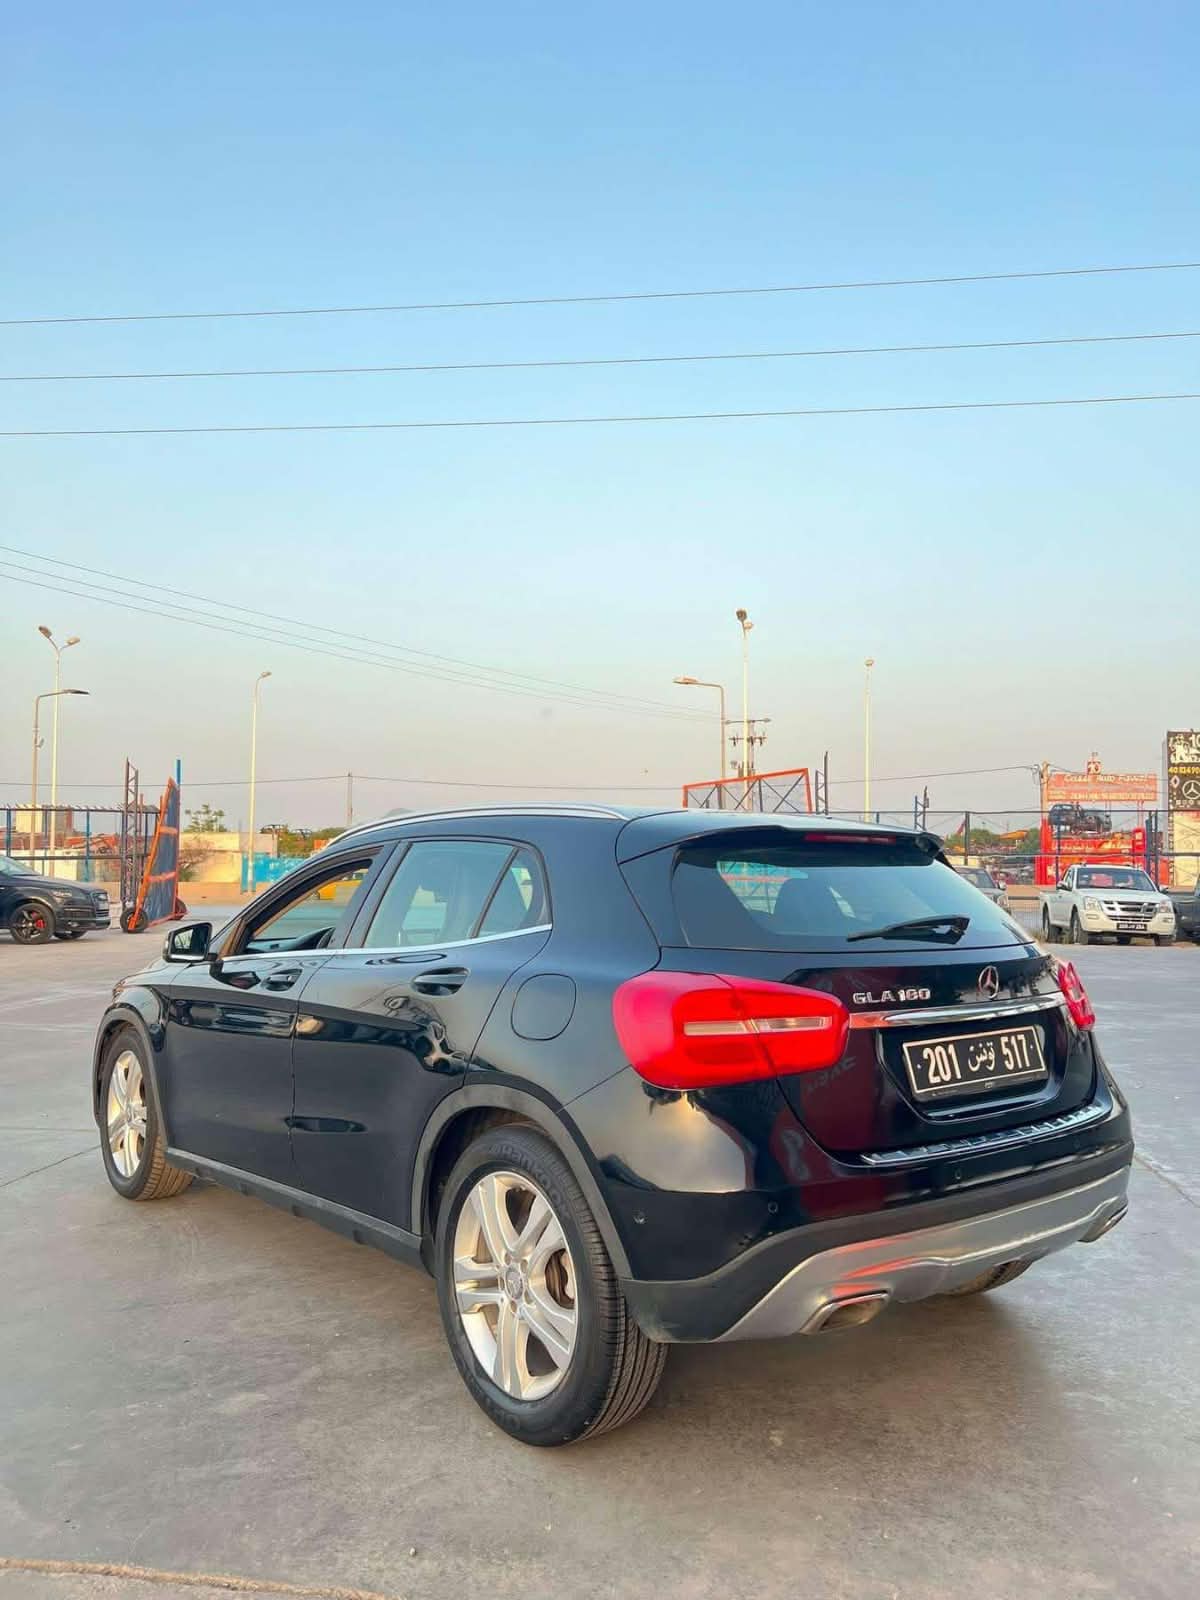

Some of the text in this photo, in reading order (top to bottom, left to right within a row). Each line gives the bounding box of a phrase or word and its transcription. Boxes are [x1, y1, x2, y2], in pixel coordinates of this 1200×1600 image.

[852, 990, 897, 1005] GLA
[922, 1034, 1030, 1084] 201 تونس 517
